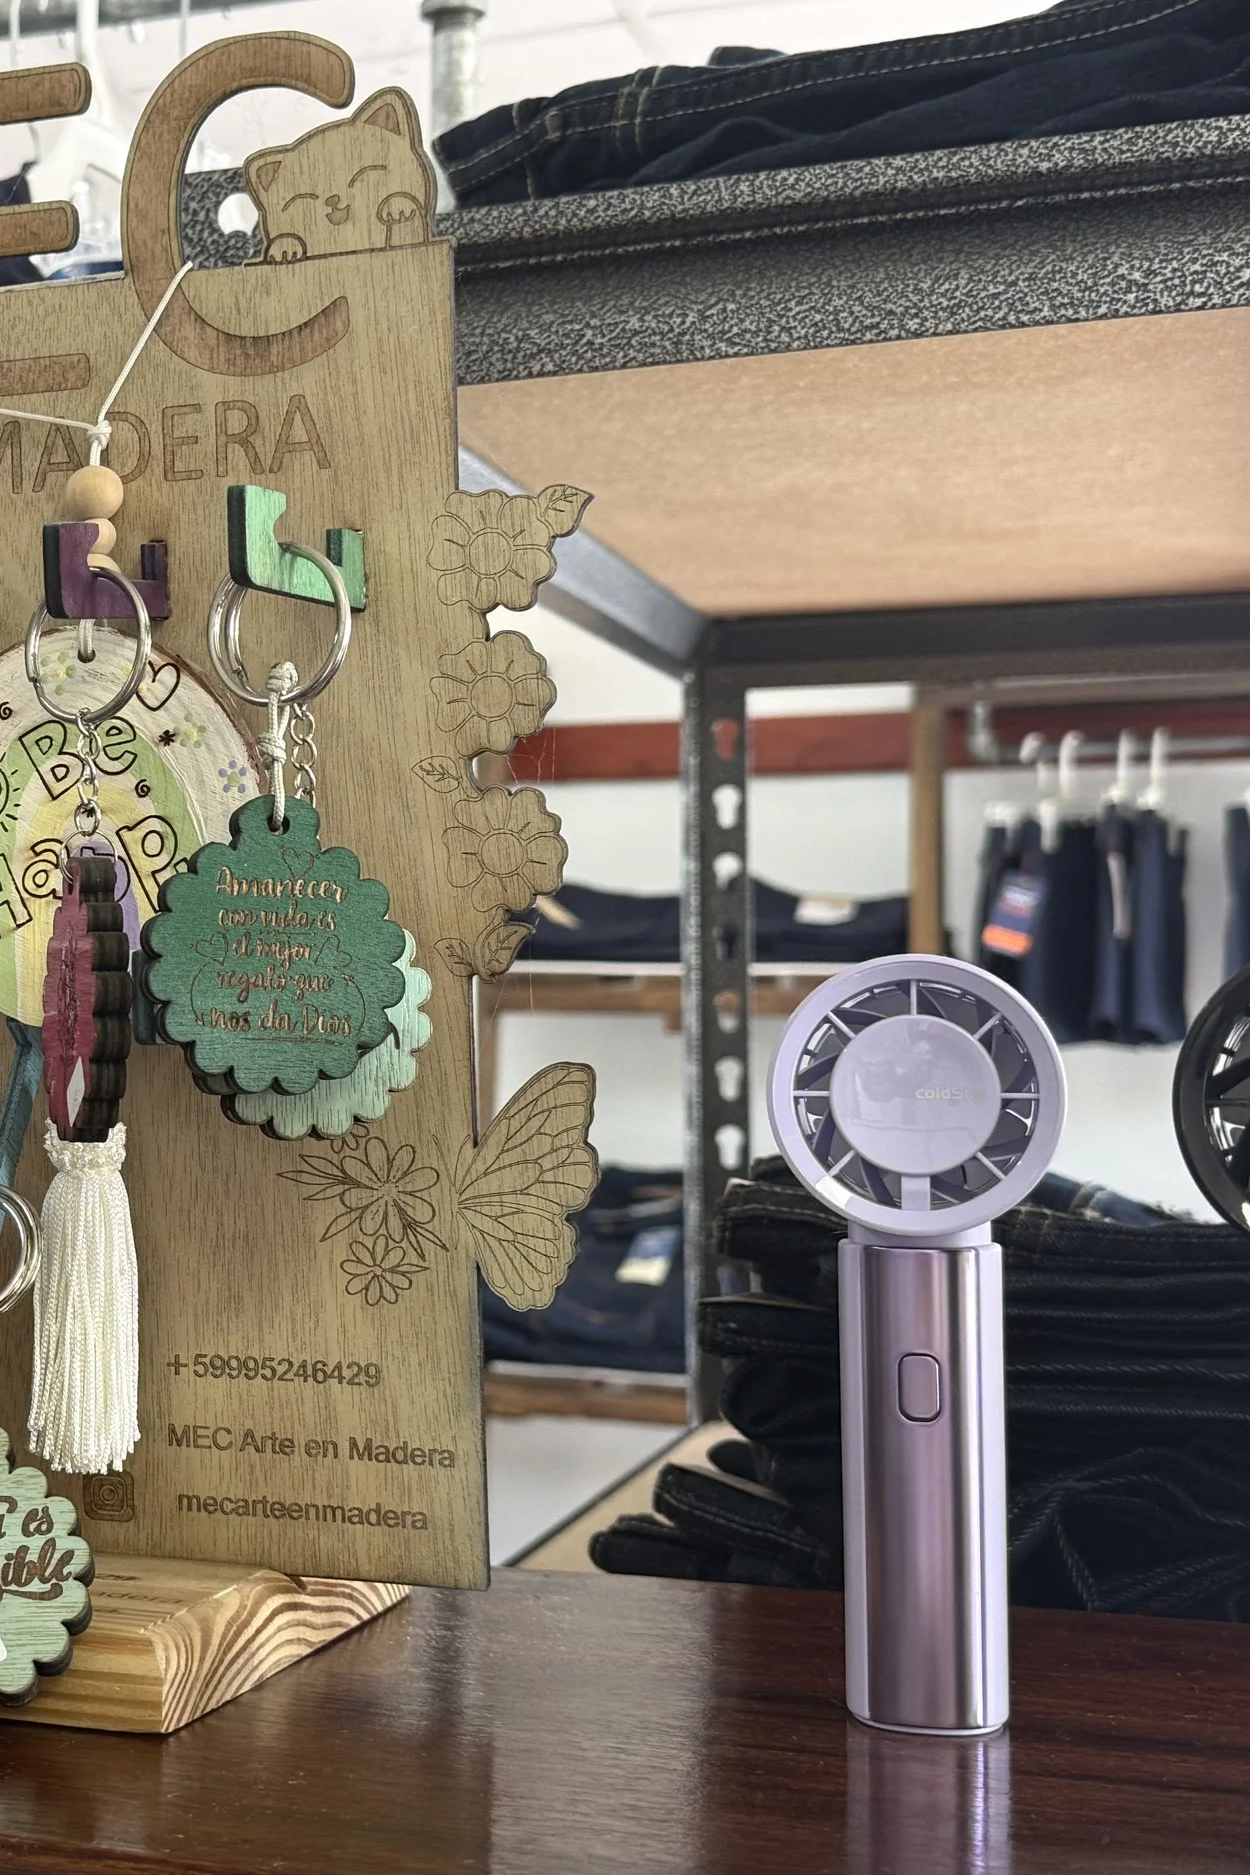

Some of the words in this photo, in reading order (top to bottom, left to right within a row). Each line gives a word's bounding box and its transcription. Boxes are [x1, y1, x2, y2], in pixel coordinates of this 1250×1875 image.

[18, 716, 138, 801] Be
[215, 866, 347, 903] Amanecer
[218, 907, 256, 928] con
[259, 899, 315, 929] vida
[316, 910, 337, 932] es
[232, 931, 254, 957] el
[255, 936, 314, 972] mejor
[217, 963, 290, 1004] regalo
[291, 972, 335, 1003] que
[210, 1007, 252, 1033] nos
[257, 999, 298, 1033] da
[303, 1003, 351, 1036] Dios
[166, 1353, 382, 1388] +59995246429
[167, 1422, 233, 1451] MEC
[239, 1428, 296, 1457] Arte
[304, 1438, 339, 1460] en
[348, 1436, 456, 1469] Madera
[21, 1505, 55, 1538] es
[177, 1492, 429, 1531] mecarteenmadera
